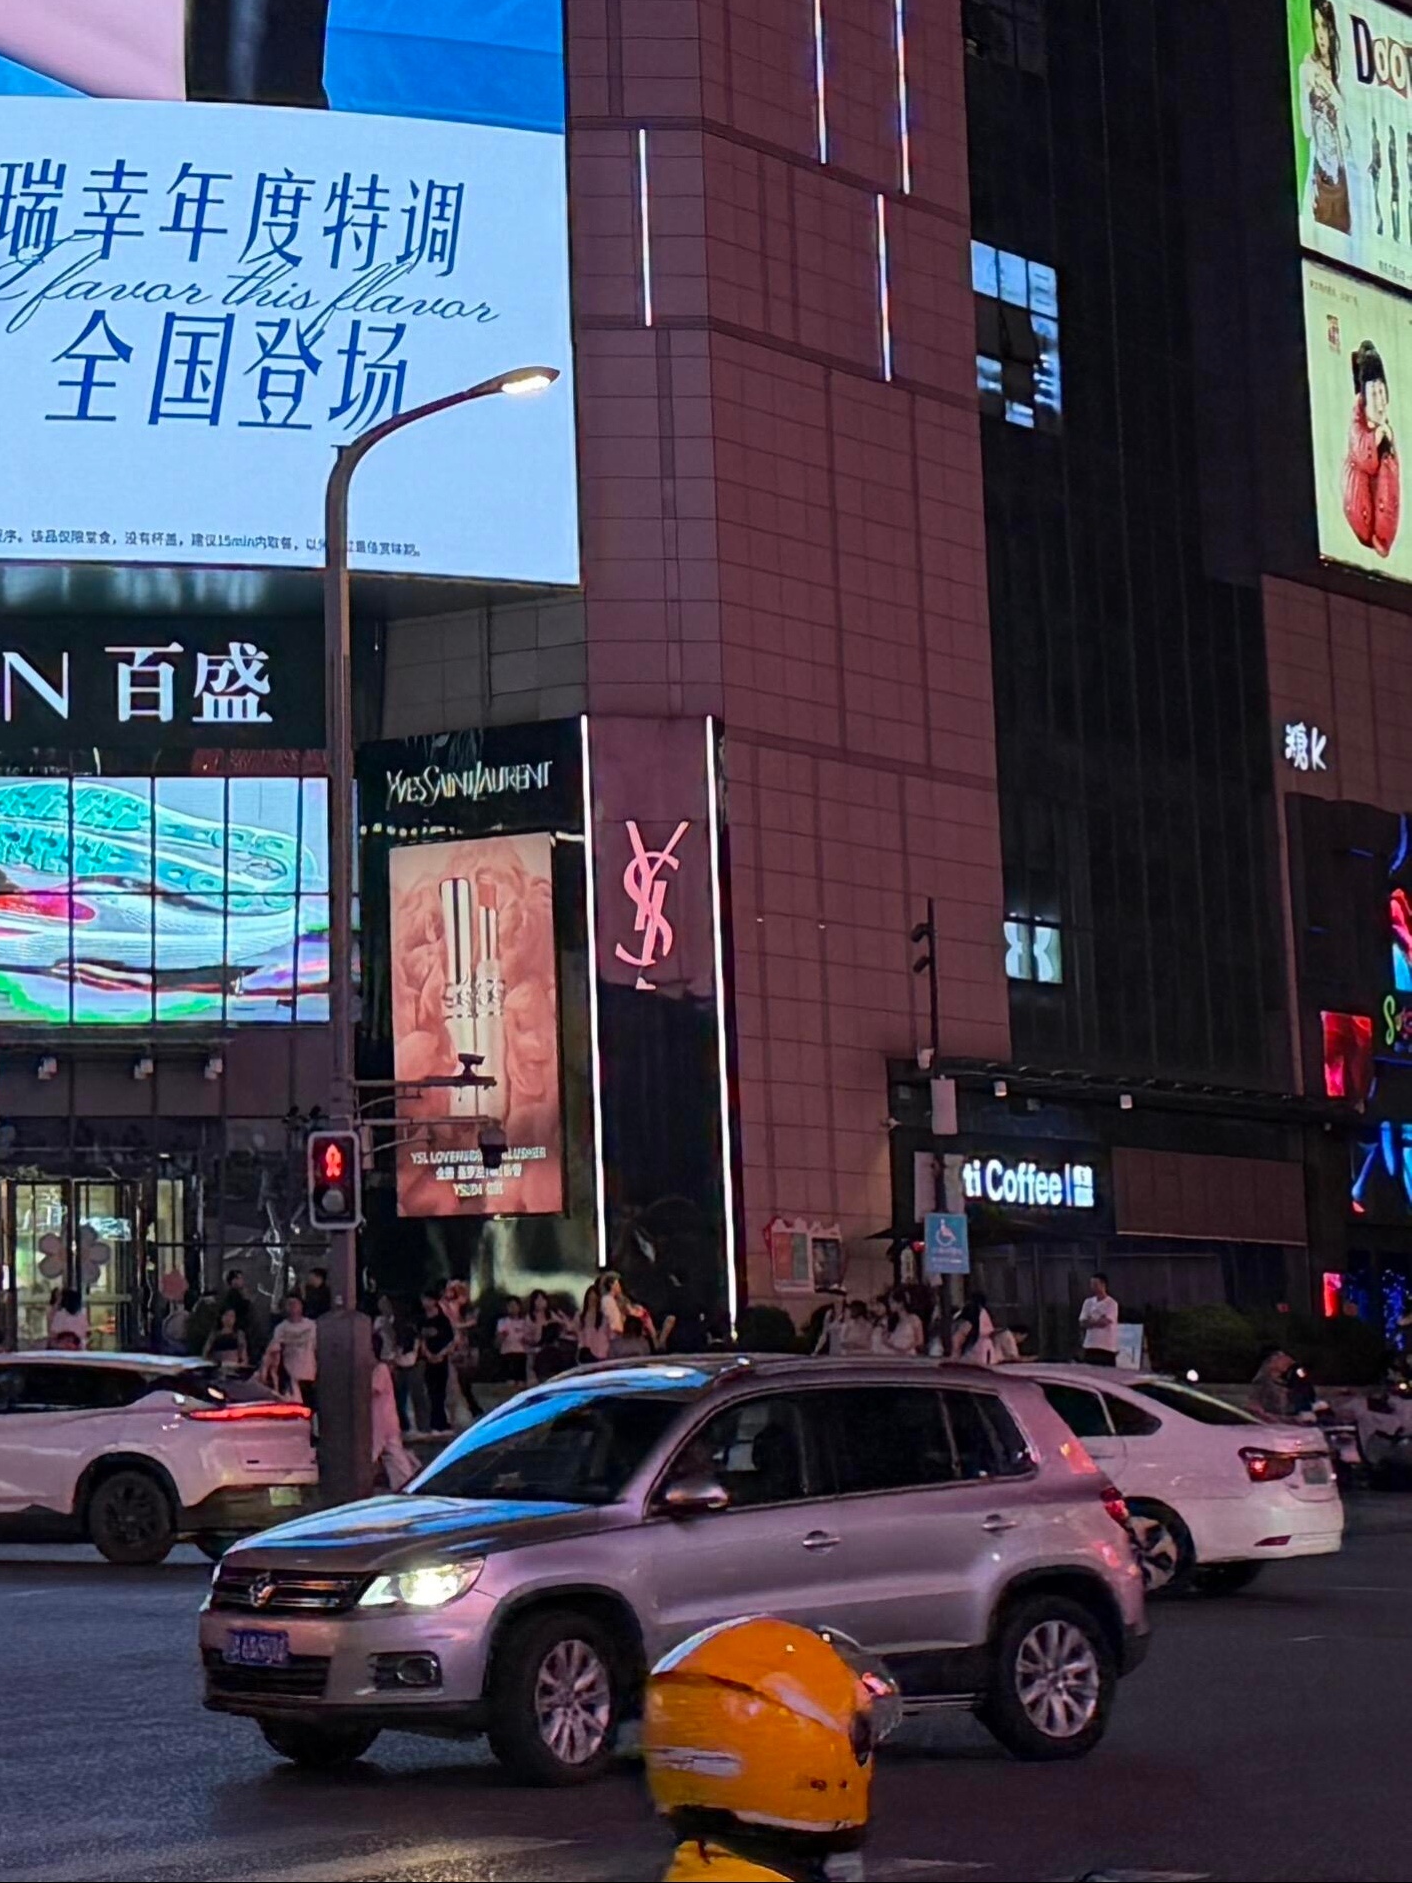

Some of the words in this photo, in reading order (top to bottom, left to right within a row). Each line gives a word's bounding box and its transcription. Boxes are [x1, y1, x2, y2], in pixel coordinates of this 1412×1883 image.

[6, 240, 213, 334] favor
[223, 258, 323, 312] this
[296, 253, 500, 344] flavor
[44, 308, 409, 432] 全国登场
[104, 641, 274, 725] 百盛
[985, 1159, 1063, 1206] Coffee
